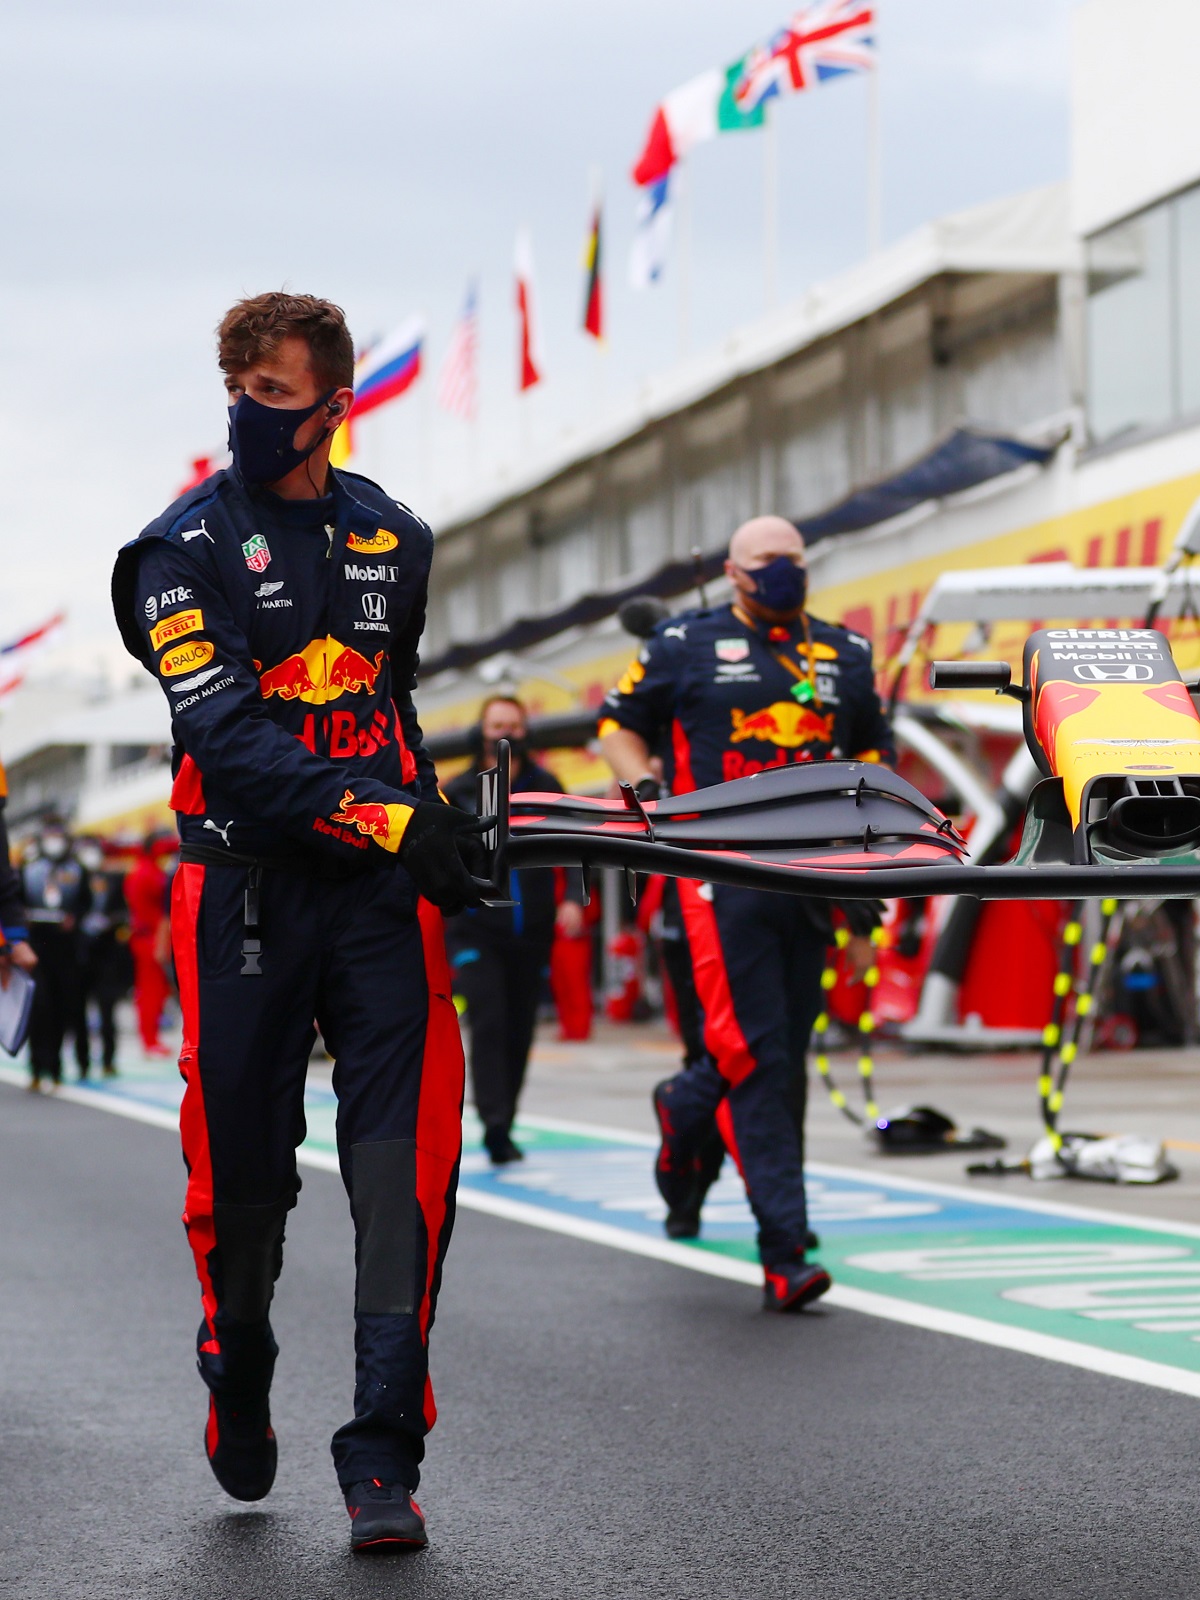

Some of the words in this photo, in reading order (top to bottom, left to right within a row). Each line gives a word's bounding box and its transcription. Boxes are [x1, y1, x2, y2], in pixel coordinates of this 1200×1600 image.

[344, 564, 385, 581] Mobil
[262, 599, 293, 609] MARTIN
[353, 621, 390, 632] HONDA
[172, 646, 209, 668] RAUCH
[1053, 652, 1132, 660] Mobil
[175, 693, 200, 714] ASTON
[201, 676, 235, 698] MARTIN
[312, 817, 342, 839] Red
[341, 830, 369, 850] Bull
